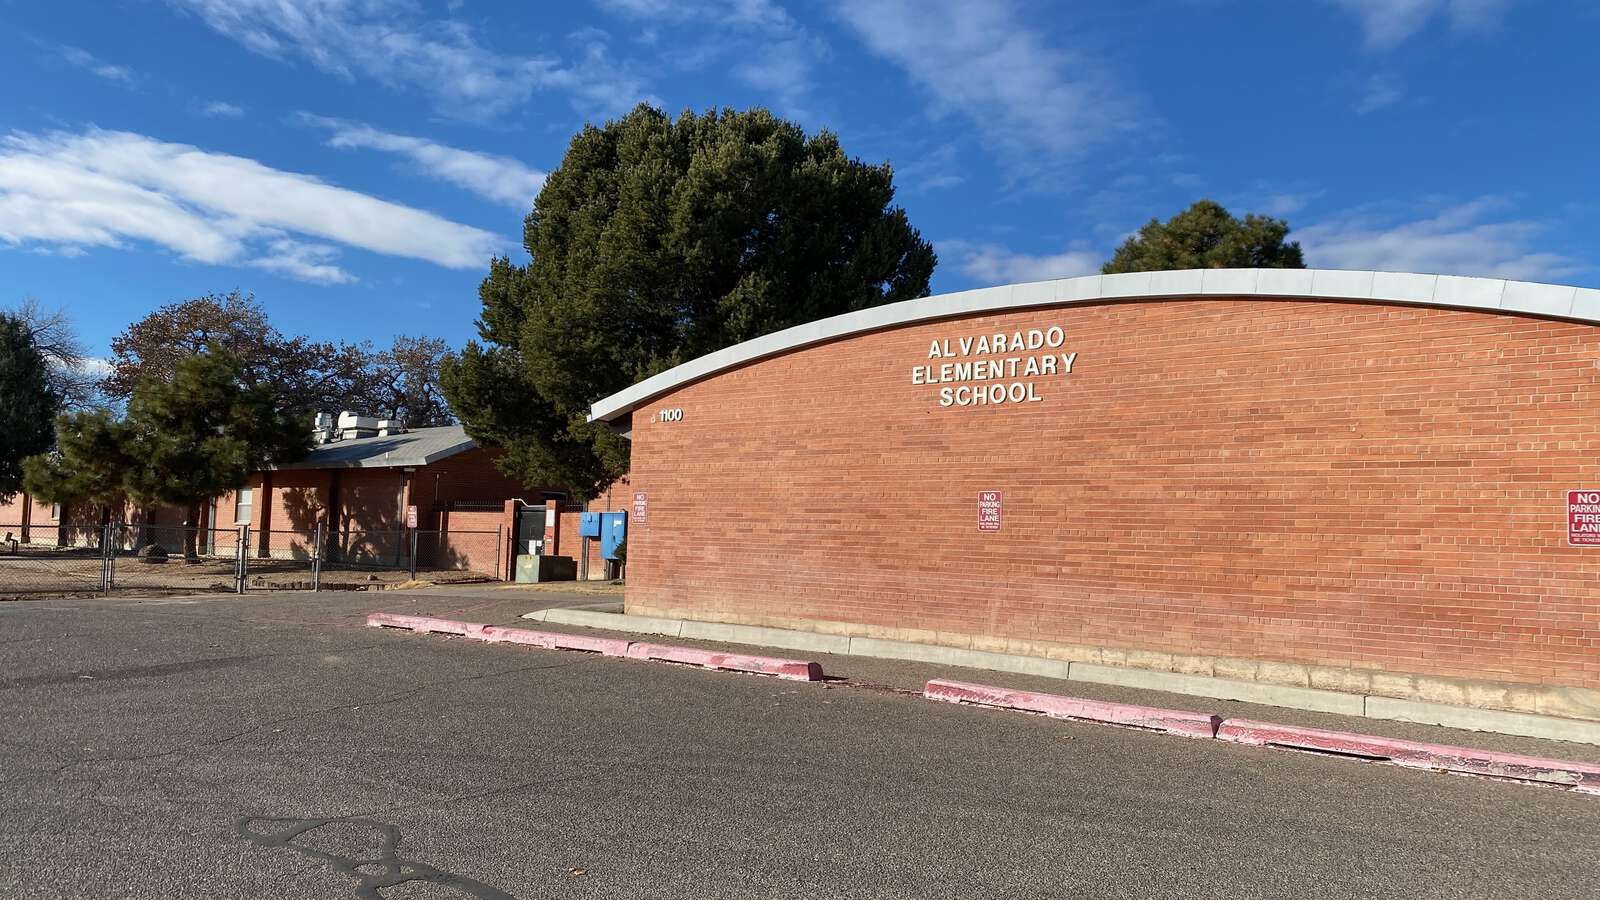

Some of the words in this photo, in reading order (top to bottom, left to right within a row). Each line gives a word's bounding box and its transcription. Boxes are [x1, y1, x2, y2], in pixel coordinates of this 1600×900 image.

[928, 326, 1065, 359] ALVARADO
[912, 352, 1078, 385] ELEMENTARY
[939, 382, 1043, 407] SCHOOL
[659, 408, 684, 422] 1100
[983, 493, 996, 501] NO
[1577, 493, 1600, 504] NO
[1570, 504, 1600, 513] PARKIN
[1574, 514, 1600, 523] FIRE
[1571, 523, 1600, 532] LAN
